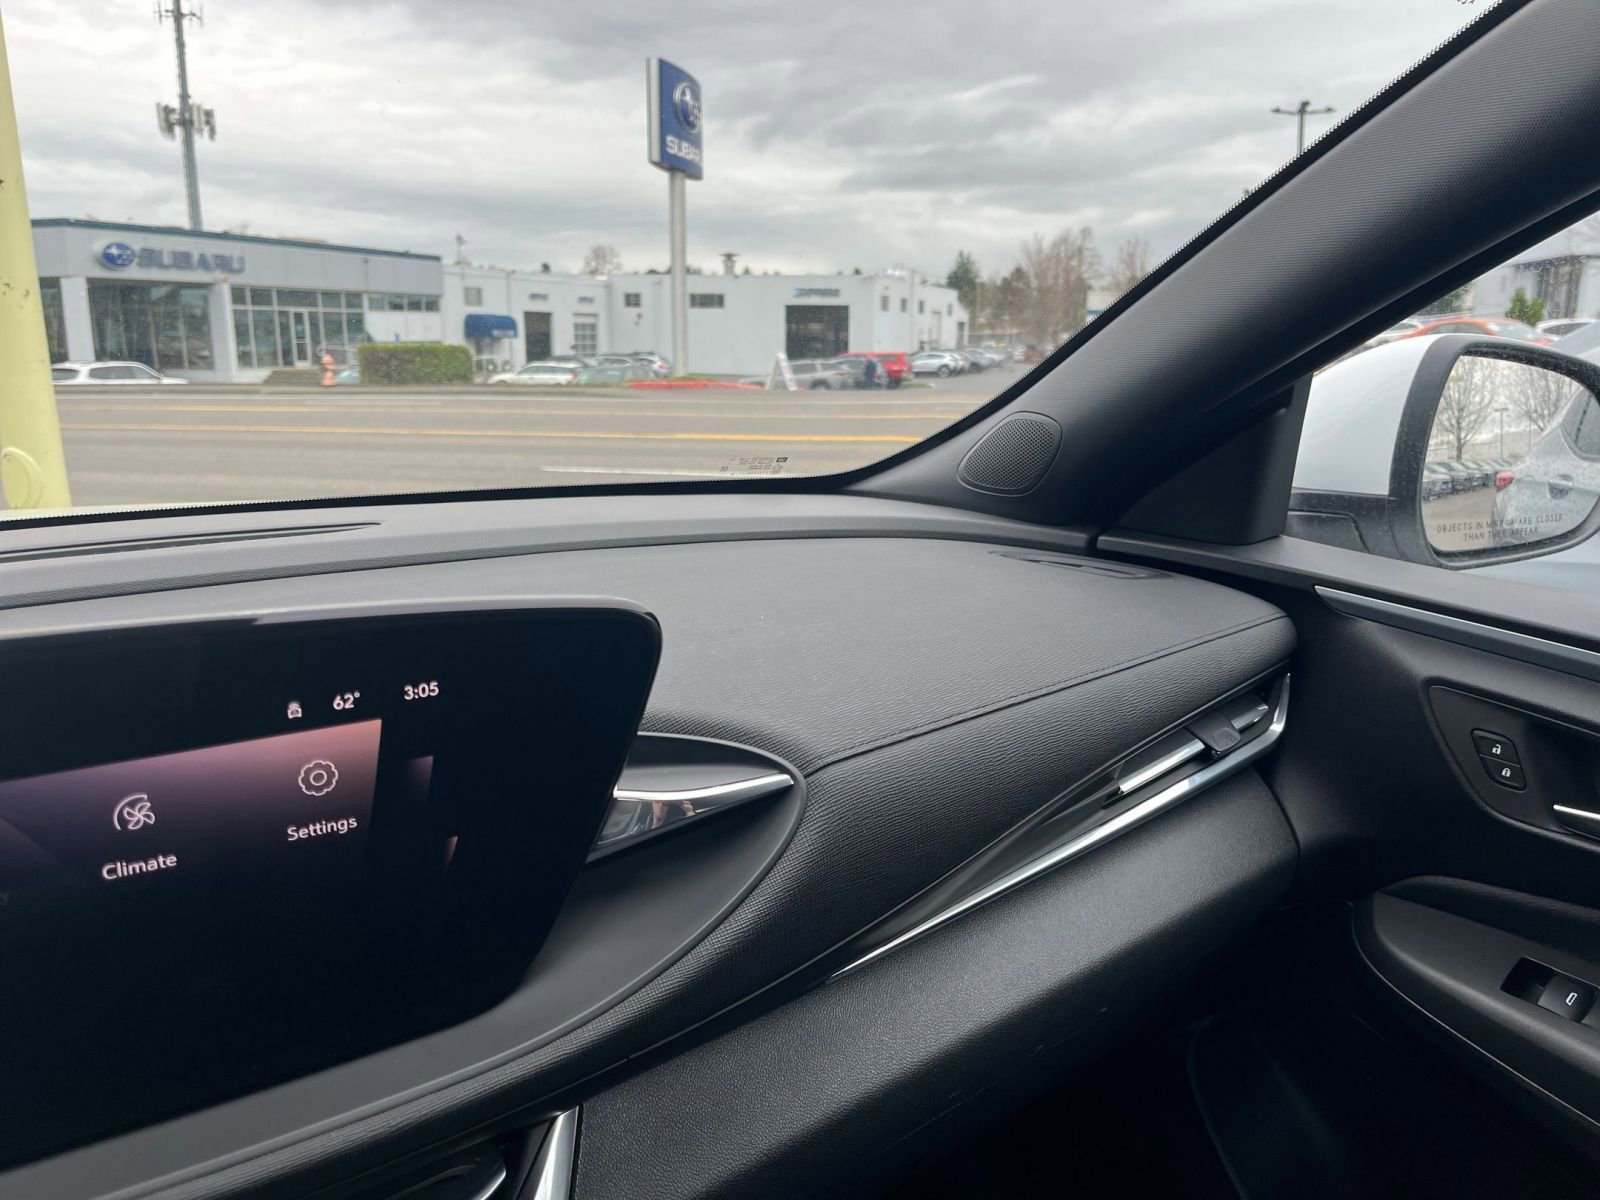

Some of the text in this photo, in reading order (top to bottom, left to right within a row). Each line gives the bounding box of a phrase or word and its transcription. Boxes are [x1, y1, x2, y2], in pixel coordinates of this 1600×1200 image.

[137, 247, 246, 274] SUBARU
[1436, 522, 1473, 533] OBJECTS
[1518, 515, 1533, 526] ARE
[1535, 512, 1564, 524] CLOSER
[1463, 531, 1485, 542] THAN
[1510, 526, 1539, 538] APPEAR
[332, 689, 361, 711] 62°
[403, 680, 440, 700] 3:05
[287, 816, 358, 842] Settings
[101, 853, 178, 880] Climate
